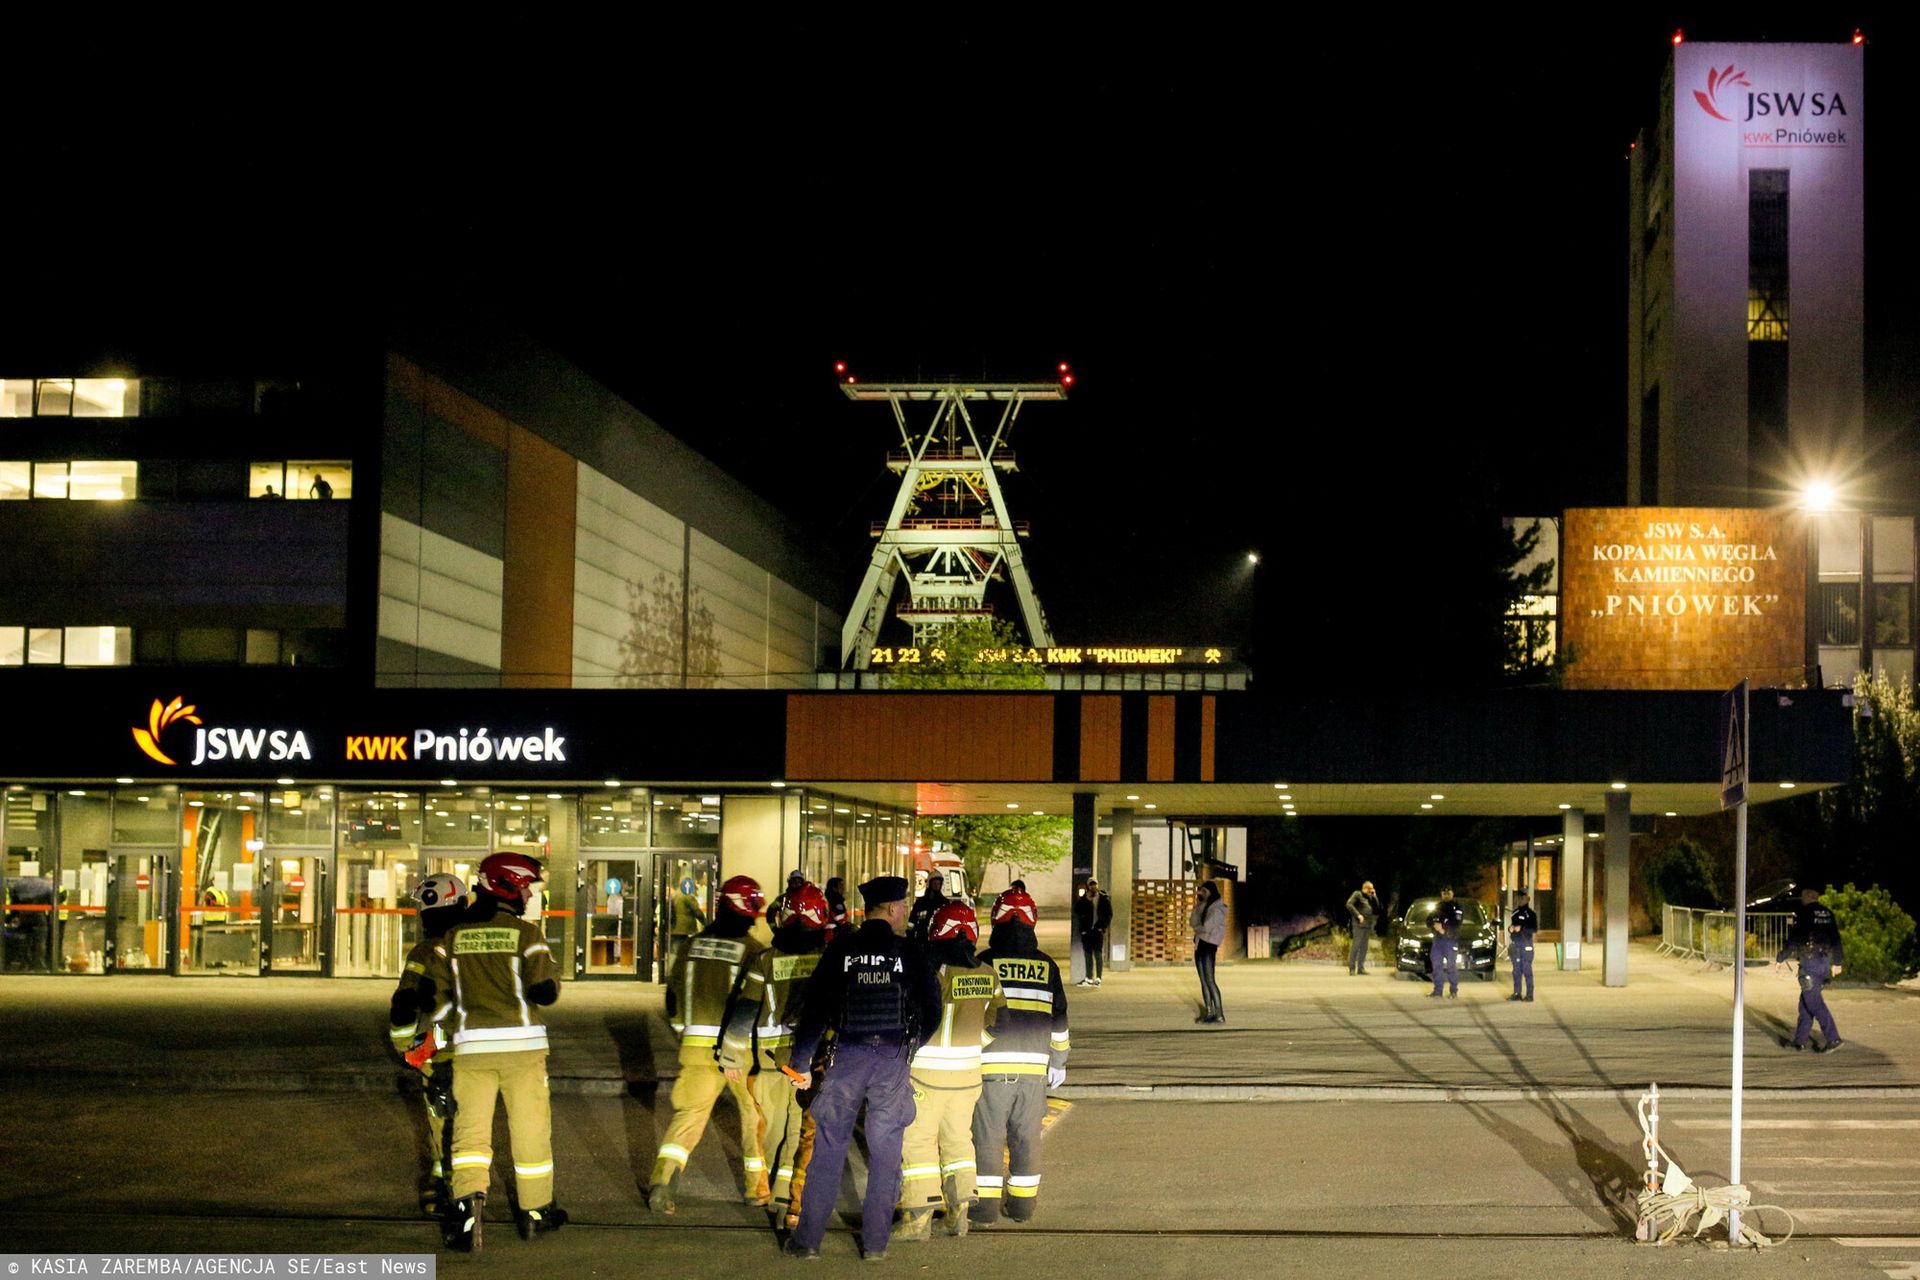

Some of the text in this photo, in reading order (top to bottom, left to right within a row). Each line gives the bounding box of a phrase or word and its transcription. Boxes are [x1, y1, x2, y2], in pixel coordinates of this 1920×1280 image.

[1744, 92, 1847, 122] JSW SA
[1744, 128, 1847, 144] KWK Pniówek
[1643, 522, 1685, 540] JSW
[1592, 544, 1777, 566] KOPALNIA WĘGLA
[1614, 566, 1756, 583] KAMIENNEGO
[871, 648, 895, 663] 21
[898, 648, 921, 663] 22
[1047, 648, 1082, 663] KWK
[191, 728, 312, 766] JSW SA
[346, 727, 567, 762] KWK Pniówek
[857, 971, 891, 984] POLICJA
[998, 962, 1046, 981] STRAŻ
